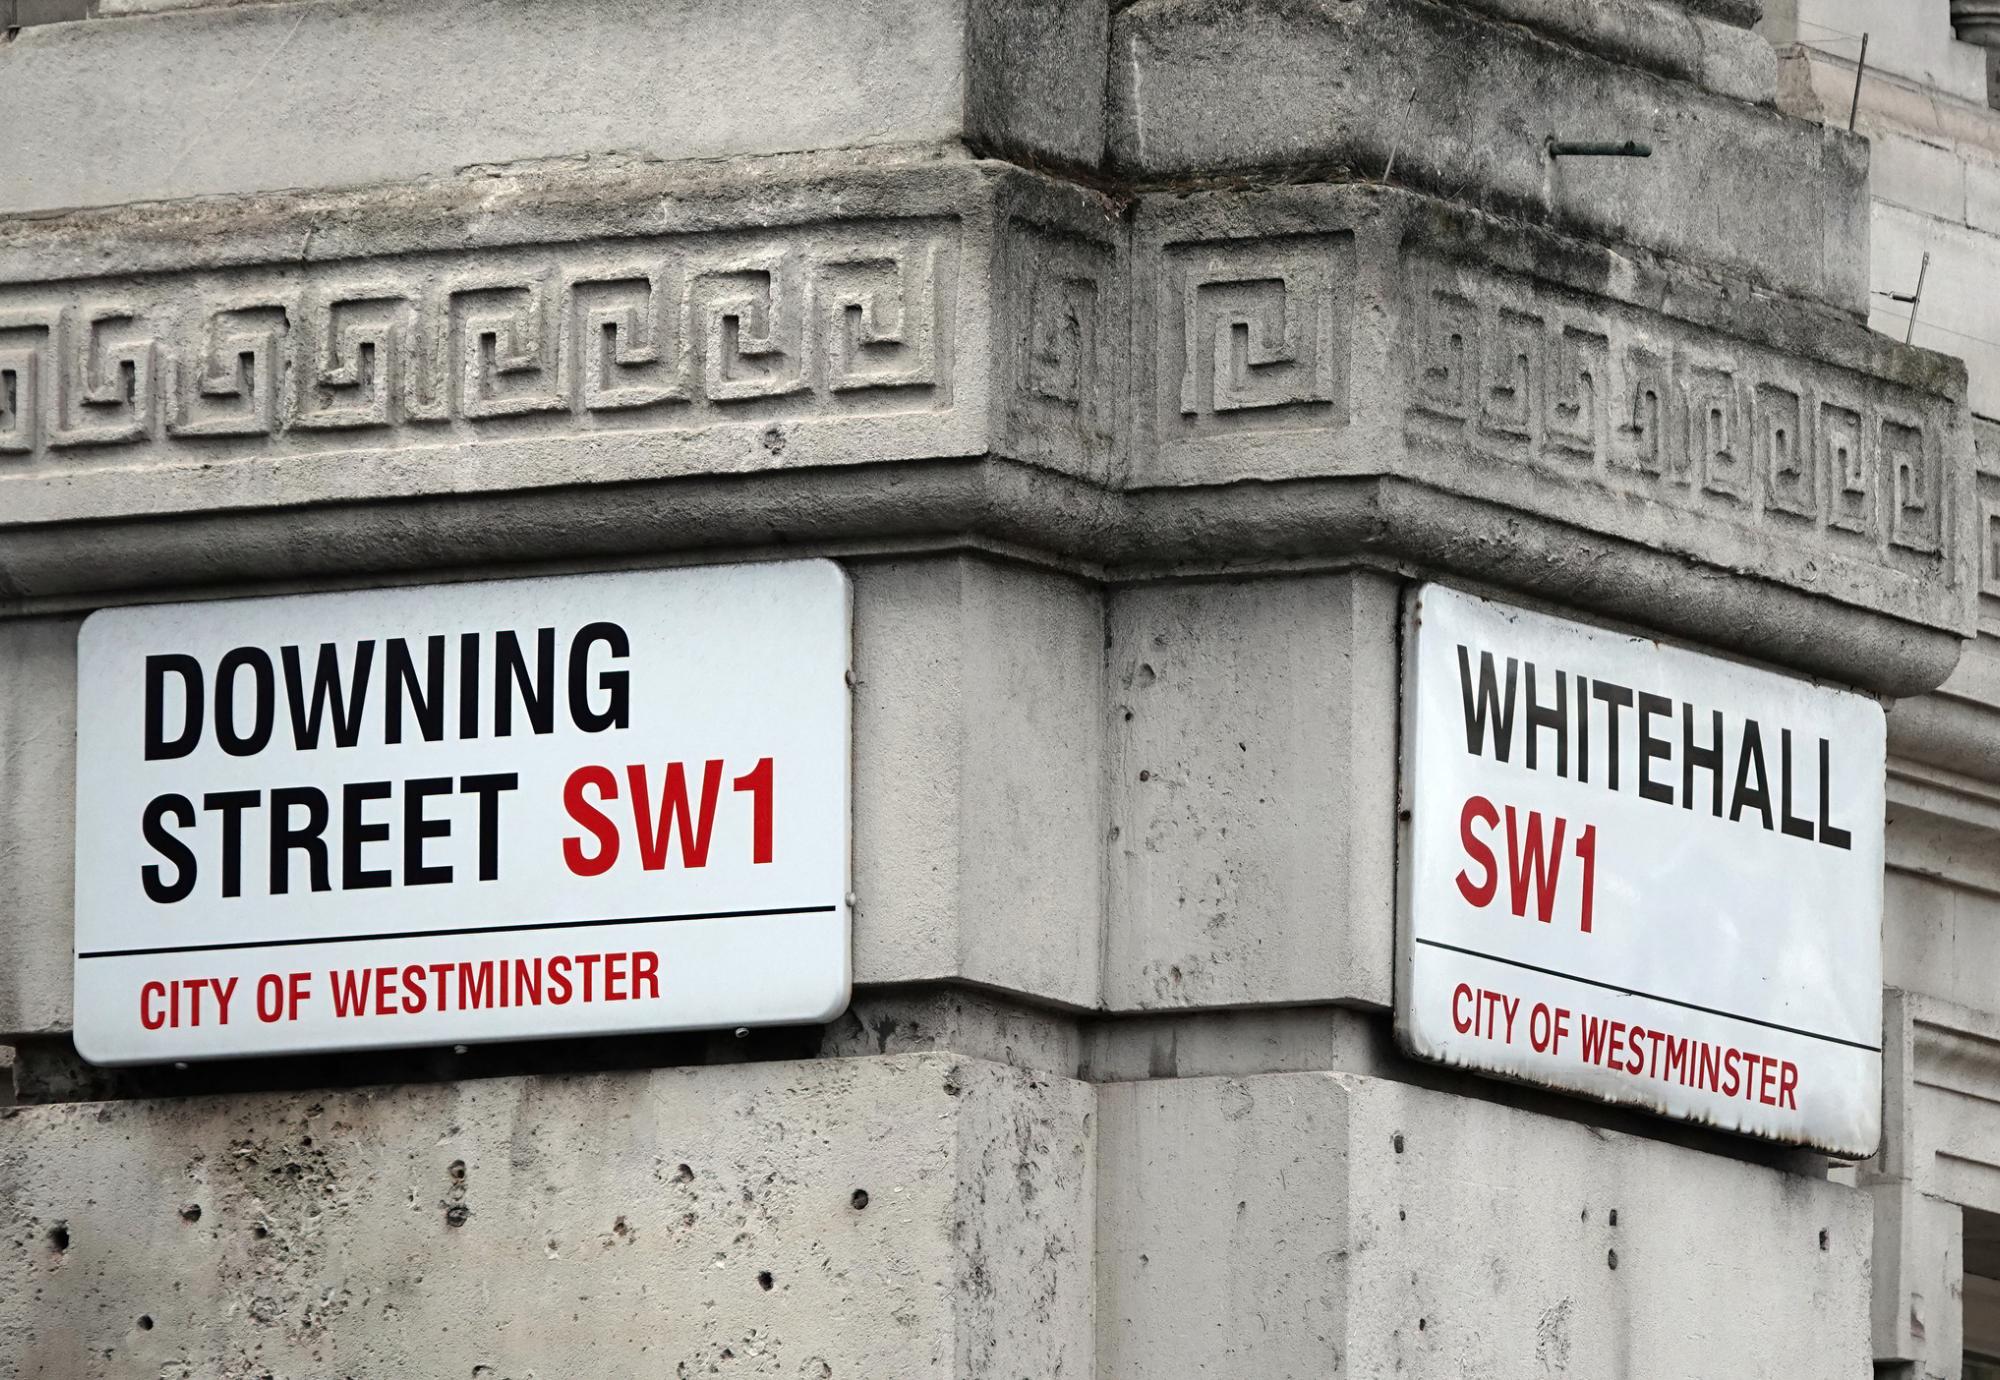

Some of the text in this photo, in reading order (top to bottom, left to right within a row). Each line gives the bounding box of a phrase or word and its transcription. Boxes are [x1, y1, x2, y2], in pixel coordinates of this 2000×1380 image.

[145, 621, 630, 762] DOWNING
[1457, 644, 1852, 851] WHITEHALL
[141, 757, 774, 904] STREET SW1
[1454, 795, 1597, 934] SW1
[140, 951, 661, 1031] CITY OF WESTMINSTER
[1451, 982, 1799, 1111] CITY OF WESTMINSTER
